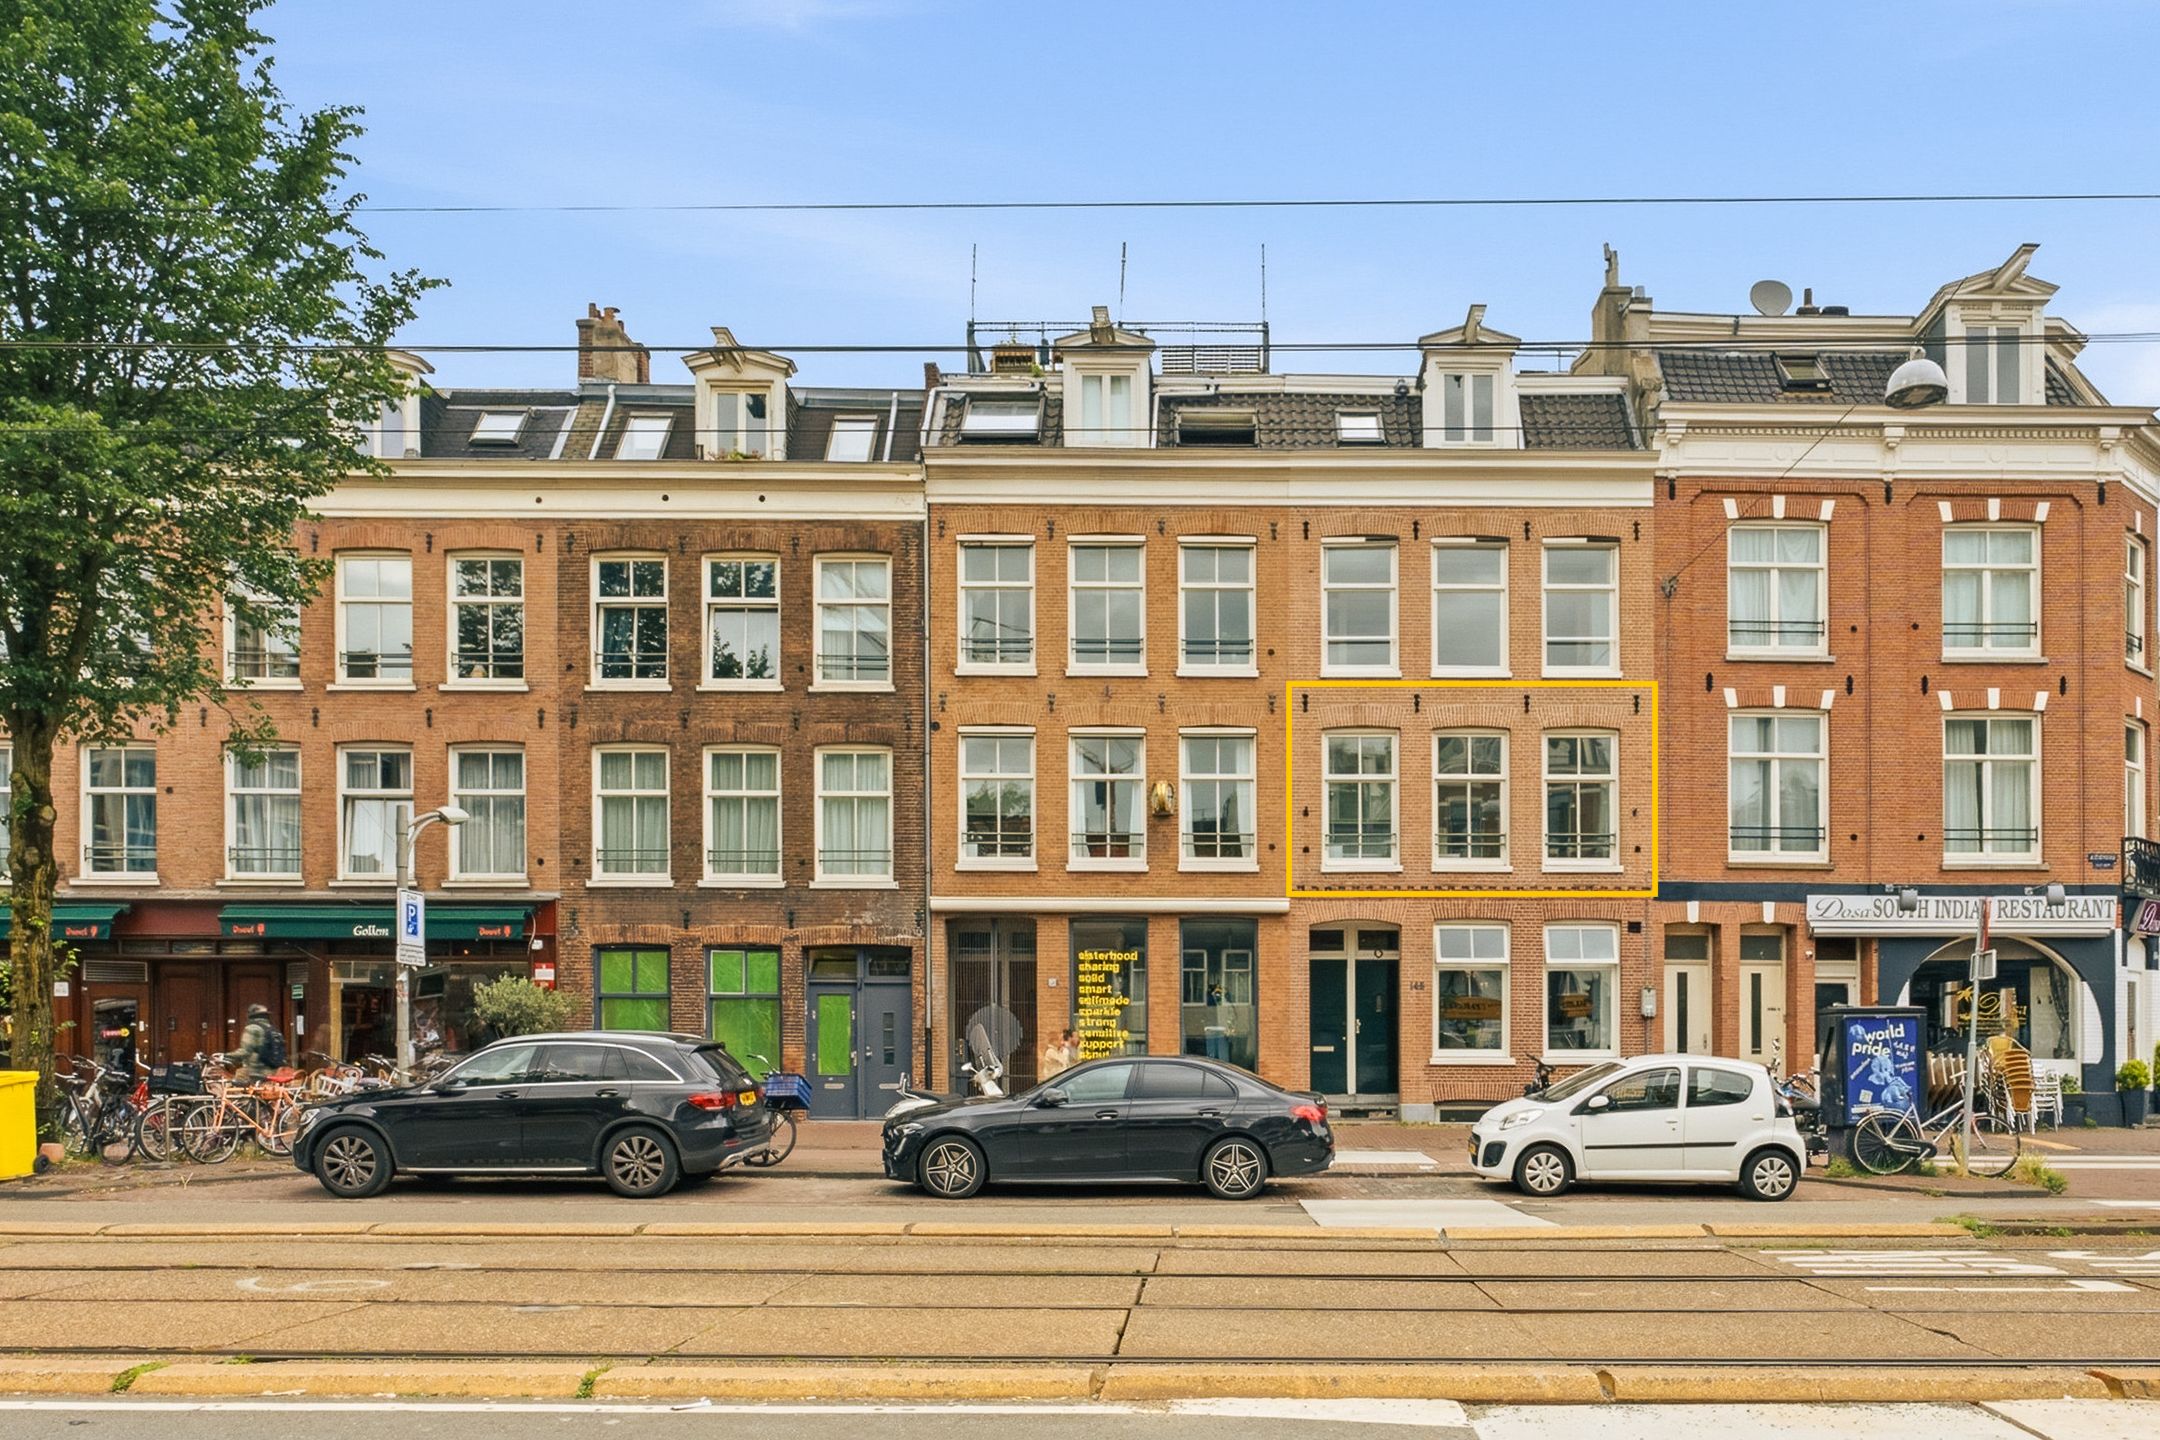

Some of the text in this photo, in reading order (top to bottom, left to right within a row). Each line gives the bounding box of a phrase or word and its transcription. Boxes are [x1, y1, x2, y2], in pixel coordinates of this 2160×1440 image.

[1815, 897, 1872, 919] Dosa
[1873, 898, 1928, 918] SOUH
[1997, 898, 2116, 919] RESTAURANT
[408, 905, 416, 922] P
[1078, 950, 1138, 960] sisterhood
[1078, 961, 1120, 973] sharing
[1078, 973, 1105, 982] solid
[1078, 985, 1112, 993] smart
[1078, 995, 1130, 1005] selfmade
[1078, 1007, 1121, 1017] sparkle
[1078, 1018, 1116, 1028] strong
[1864, 1023, 1905, 1045] world
[1079, 1039, 1125, 1050] support
[1851, 1041, 1891, 1057] pride
